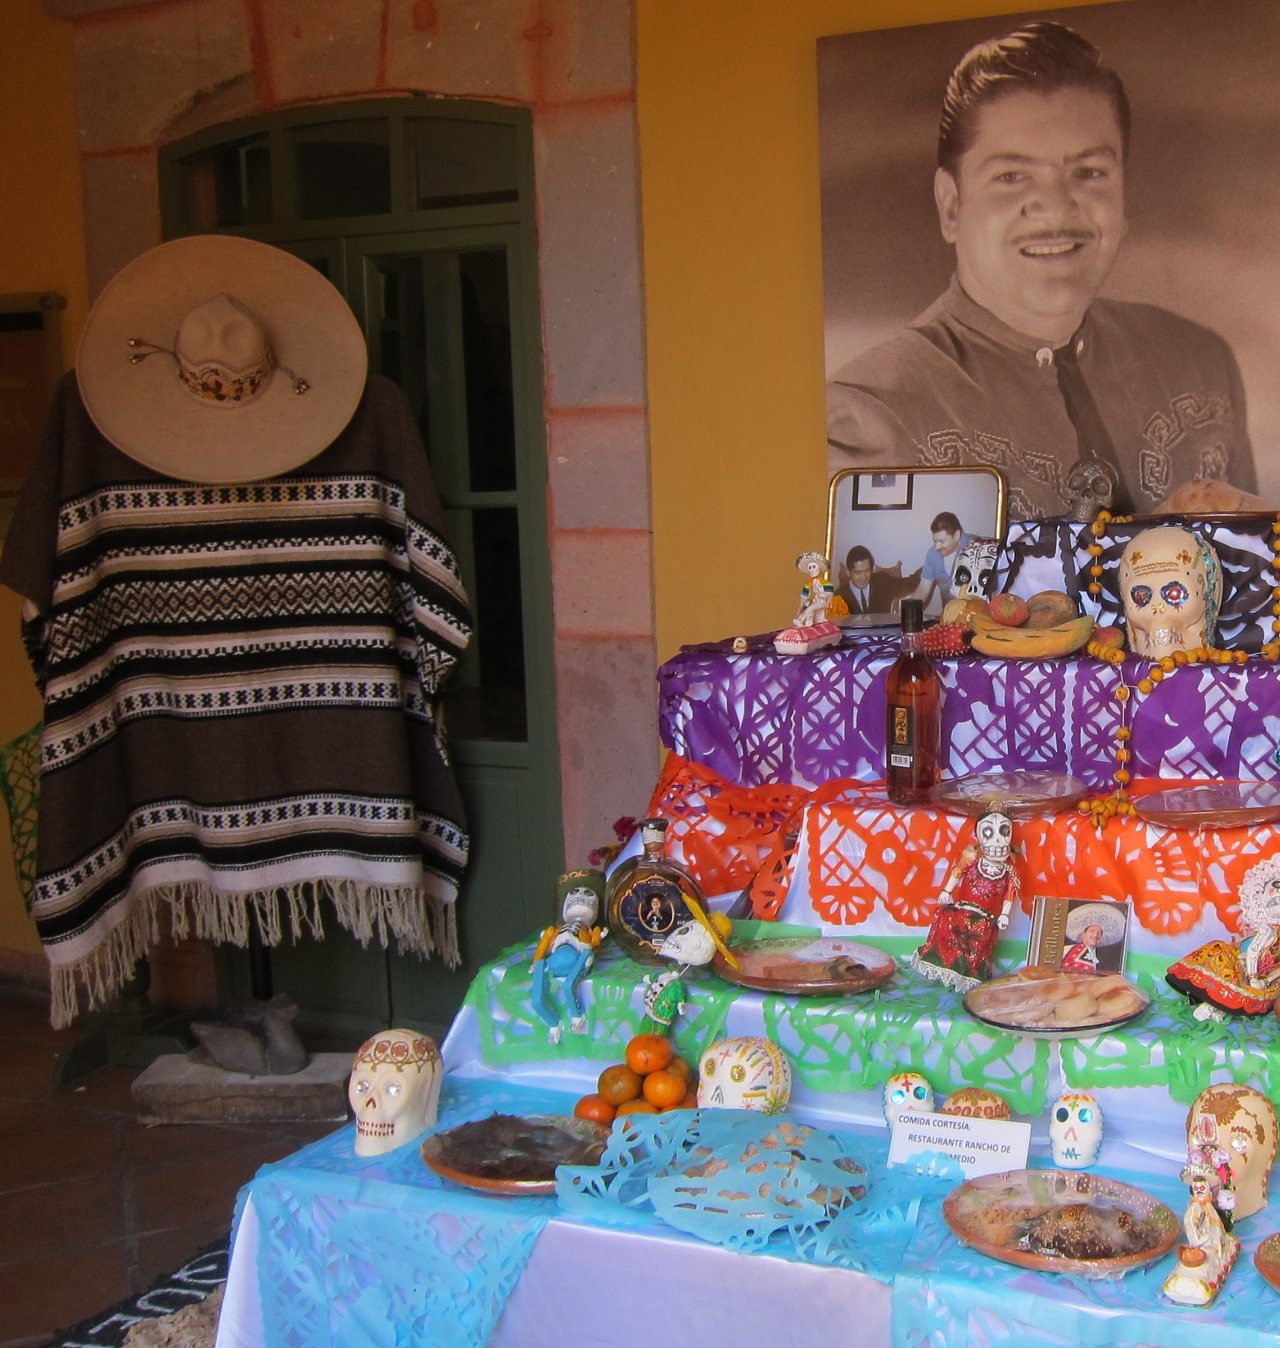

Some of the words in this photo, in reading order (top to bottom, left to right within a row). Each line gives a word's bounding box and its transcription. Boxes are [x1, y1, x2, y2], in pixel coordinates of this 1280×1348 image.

[1044, 903, 1062, 964] Brillantes
[898, 1115, 930, 1126] COMIDA
[932, 1120, 971, 1131] CORTESÍA.
[908, 1134, 963, 1148] RESTAURANTE
[965, 1141, 999, 1152] RANCHO
[943, 1153, 976, 1164] MEDIO
